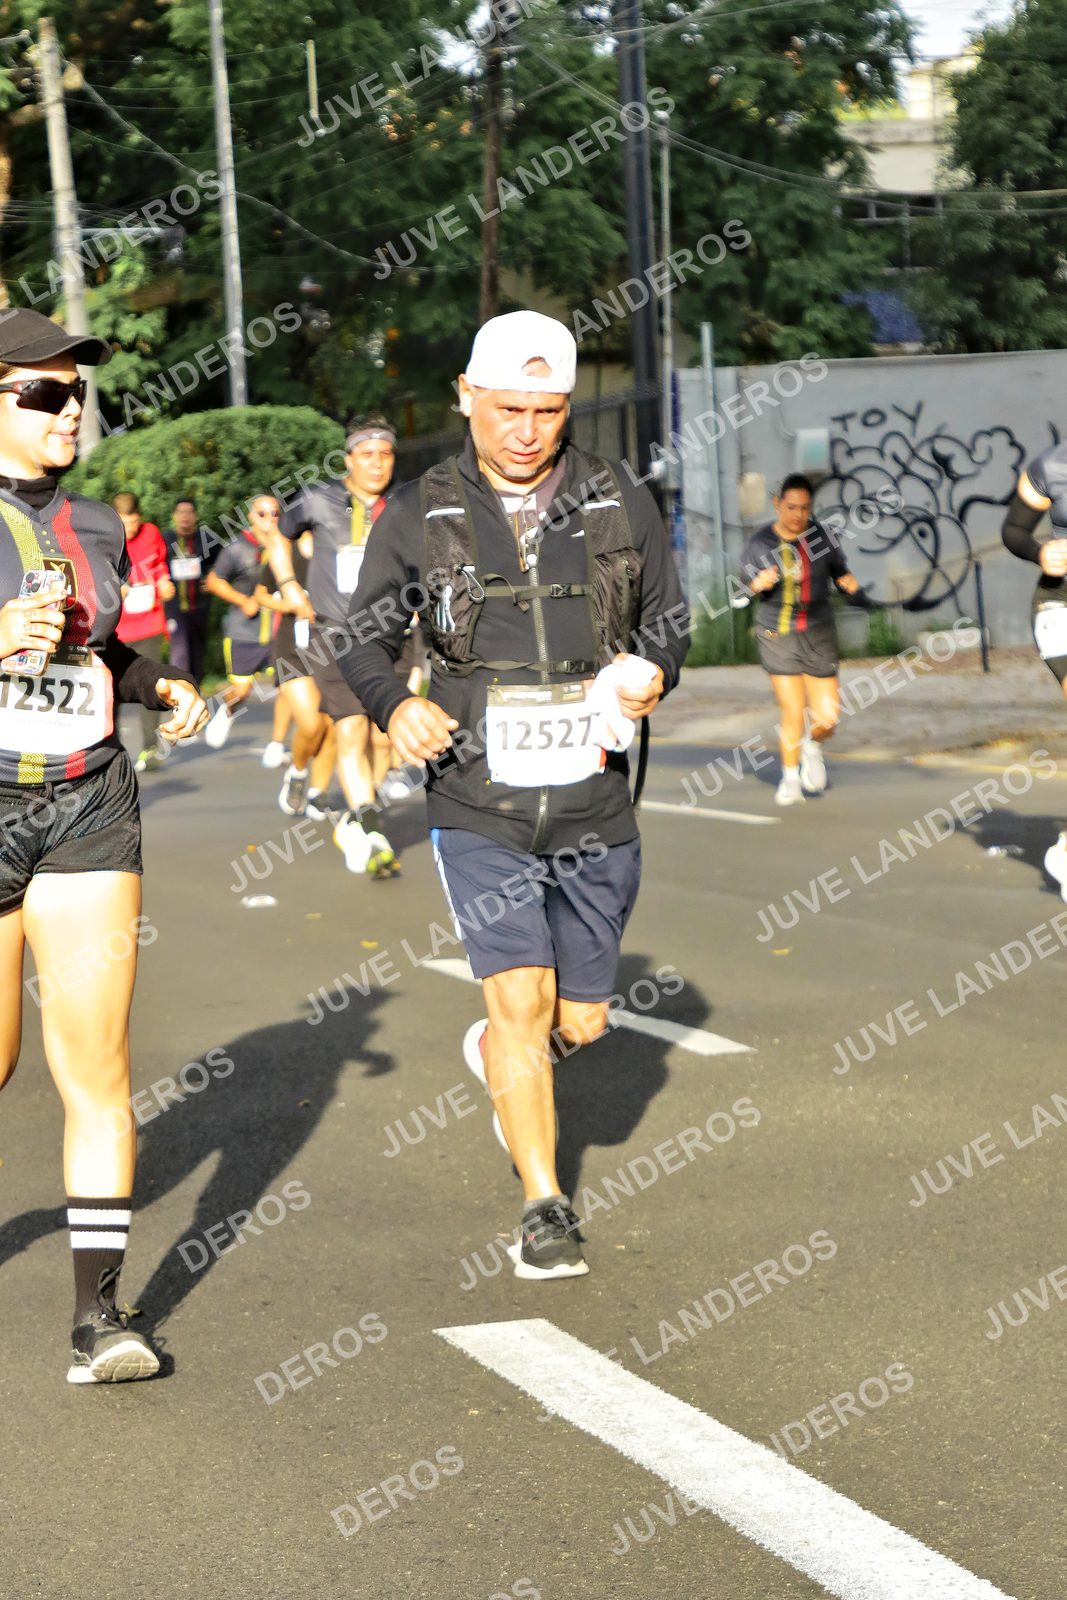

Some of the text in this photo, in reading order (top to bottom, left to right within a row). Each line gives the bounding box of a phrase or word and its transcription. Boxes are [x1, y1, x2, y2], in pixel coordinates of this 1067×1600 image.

[831, 400, 923, 437] TOY
[0, 673, 95, 716] 12522
[496, 715, 592, 751] 12527
